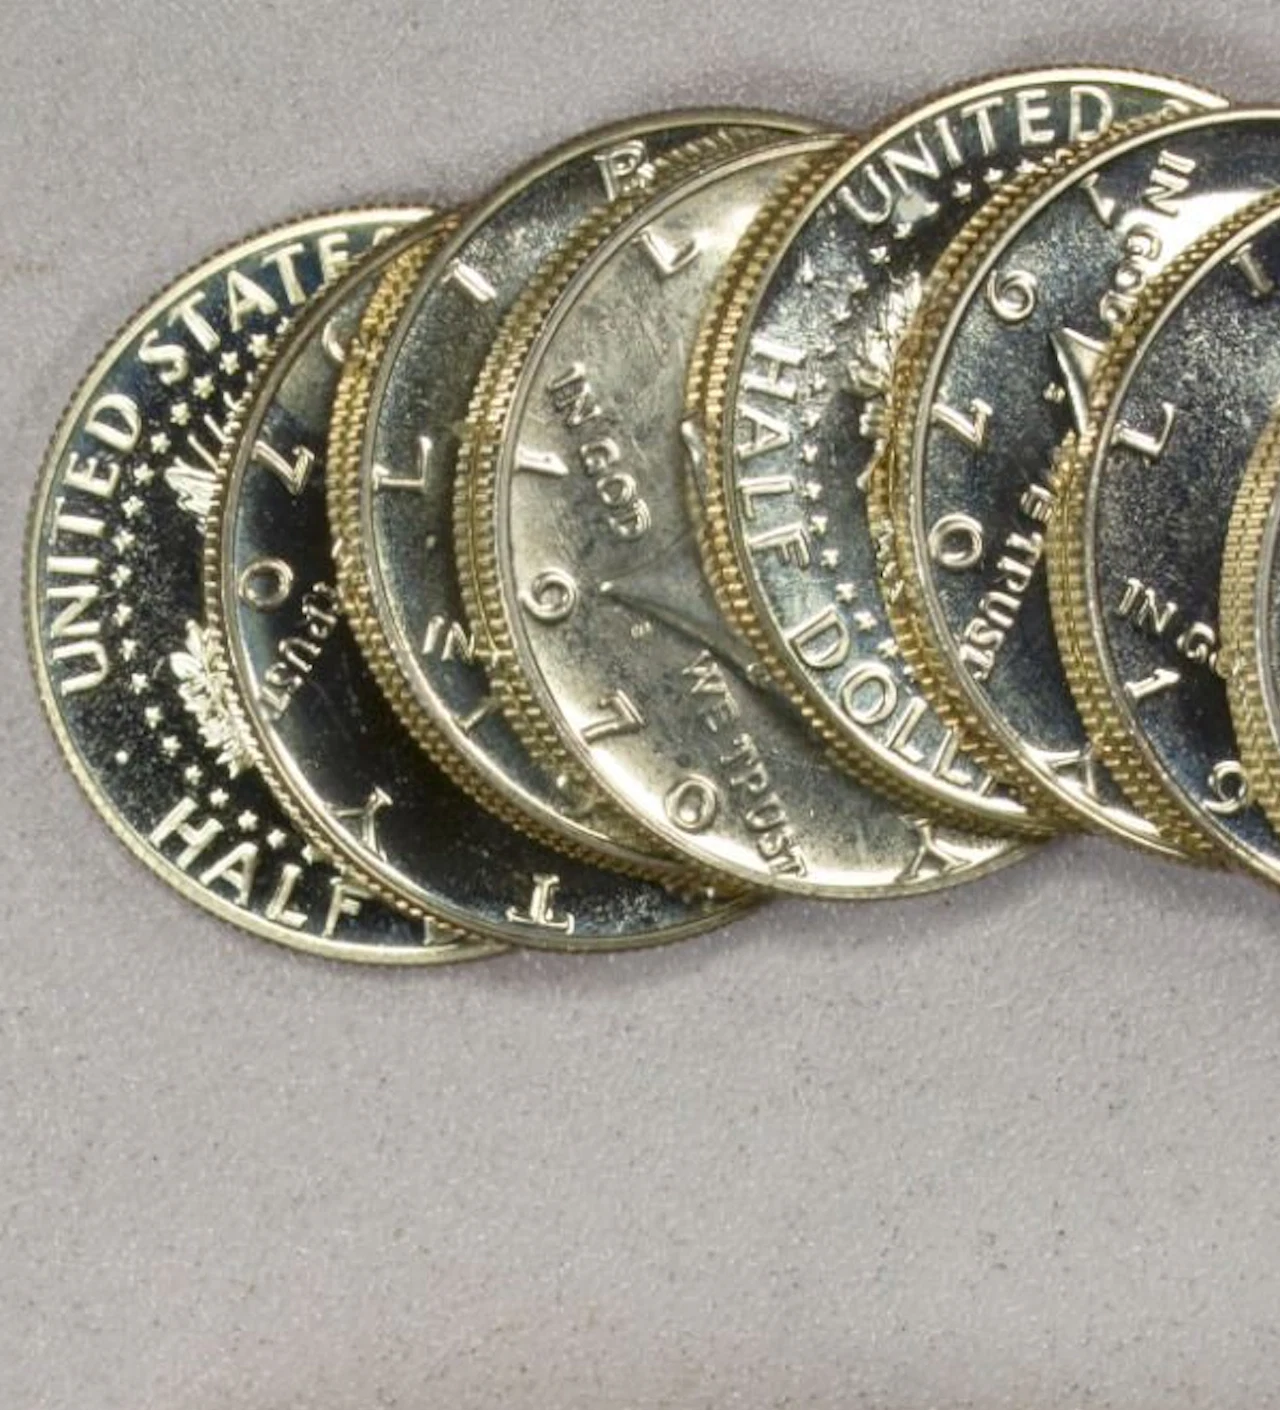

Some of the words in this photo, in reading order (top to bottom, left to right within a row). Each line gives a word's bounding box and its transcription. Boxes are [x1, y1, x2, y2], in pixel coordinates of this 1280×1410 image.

[836, 85, 1115, 226] UNITED
[45, 394, 142, 696] UNITED
[138, 229, 397, 386] STATE
[734, 335, 812, 569] HALF
[786, 604, 998, 797] DOLL
[516, 446, 718, 833] 1970
[958, 532, 1044, 682] TRUST
[151, 797, 370, 938] HALF
